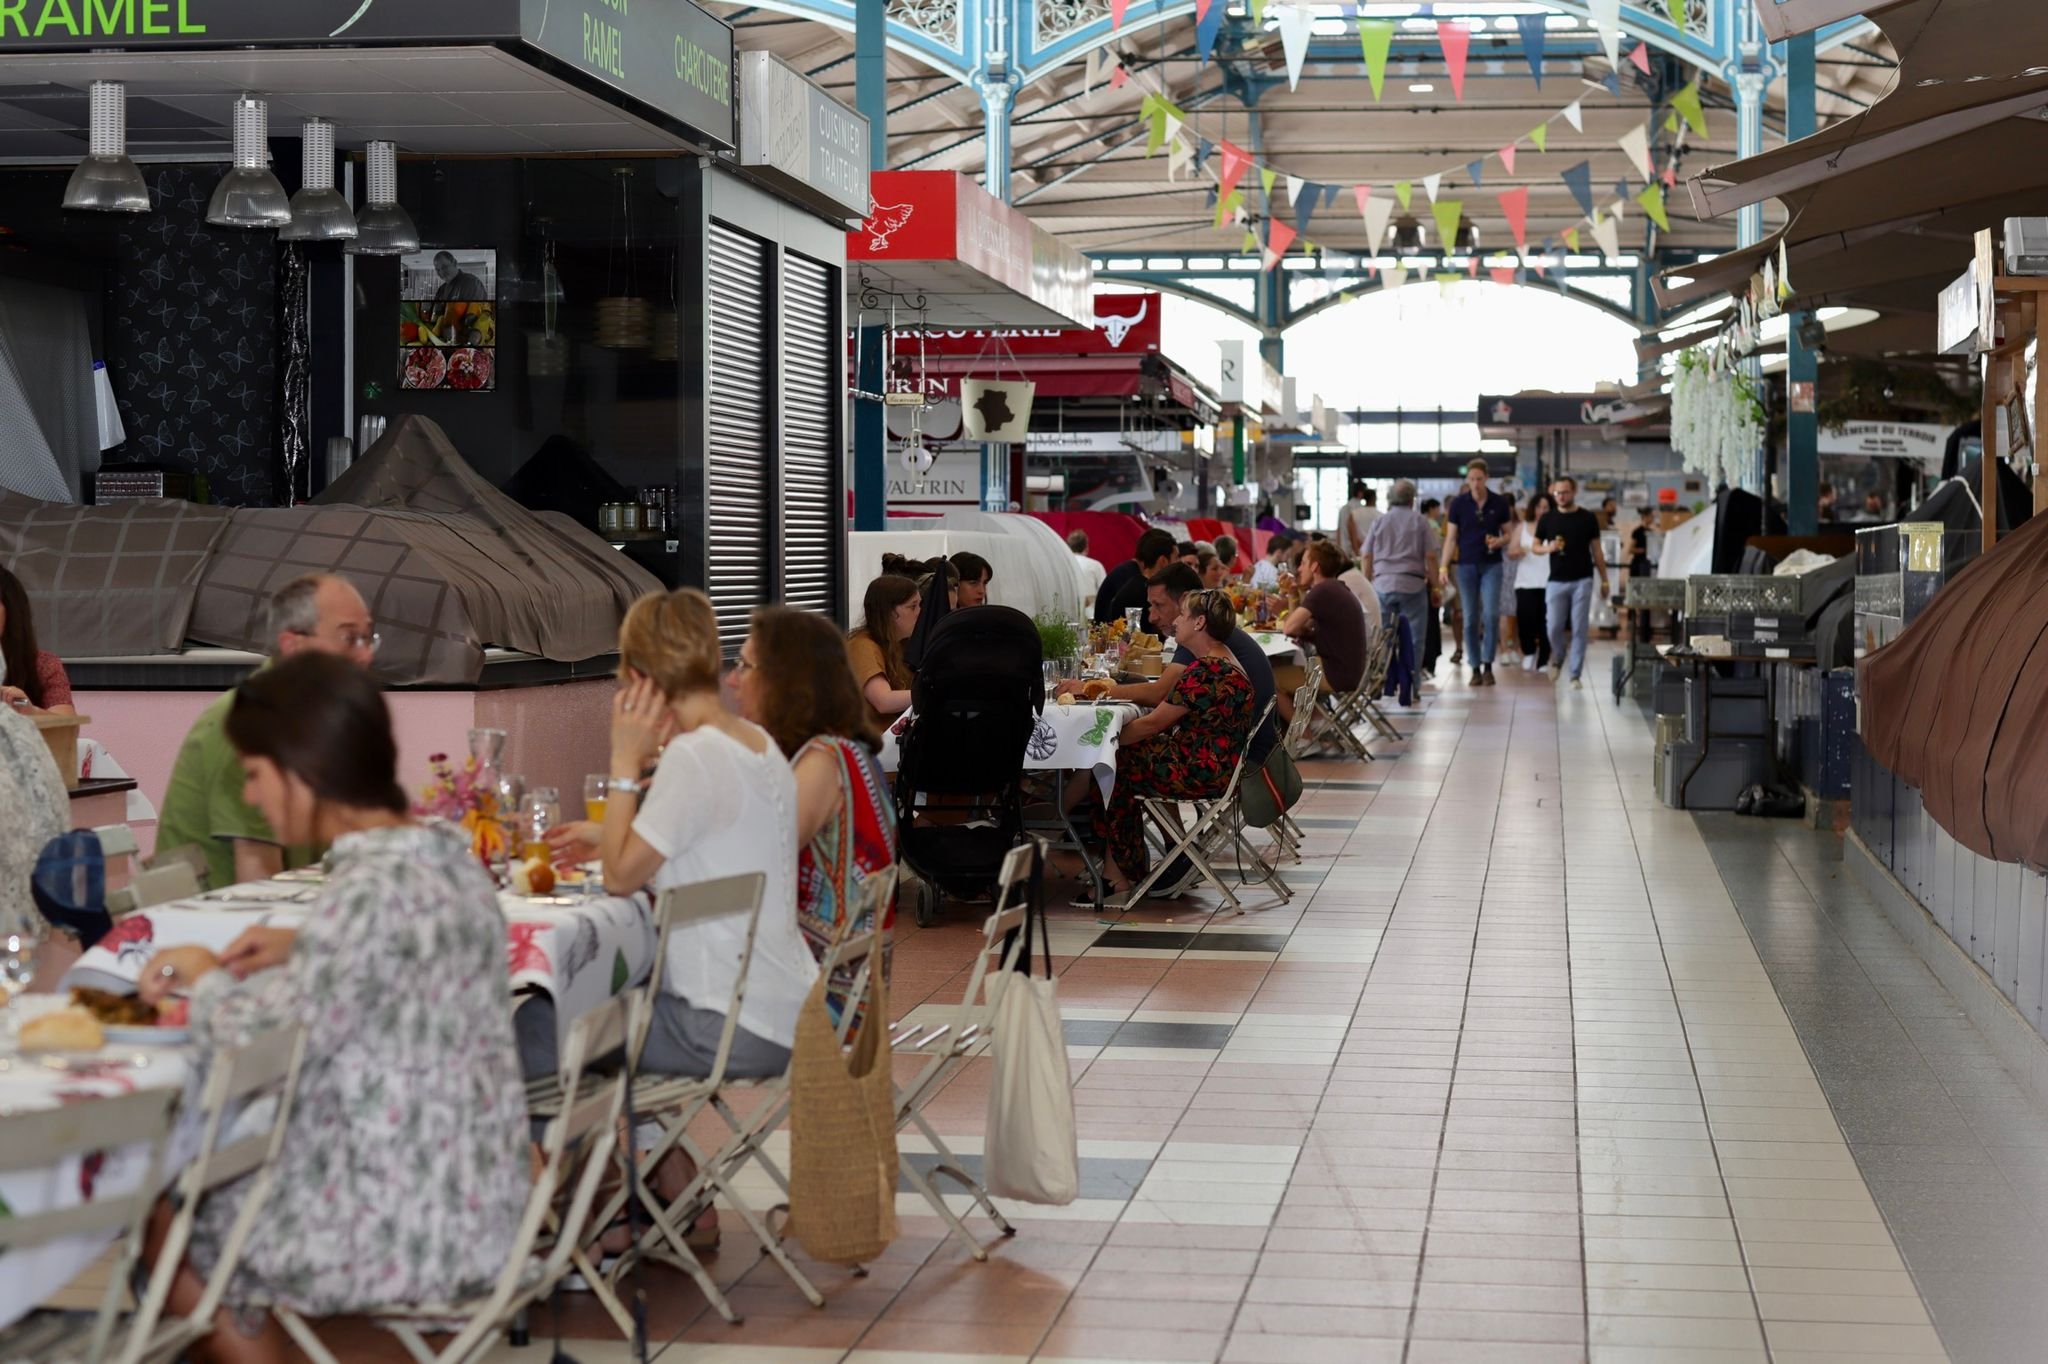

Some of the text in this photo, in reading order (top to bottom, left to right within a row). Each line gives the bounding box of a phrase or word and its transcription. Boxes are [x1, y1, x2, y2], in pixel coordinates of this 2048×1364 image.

[0, 0, 206, 37] RAMEL
[583, 12, 625, 79] RAMEL
[674, 34, 729, 107] CHARCUTERIE
[819, 104, 860, 158] CUISINIER
[820, 146, 860, 196] TRAITEUR
